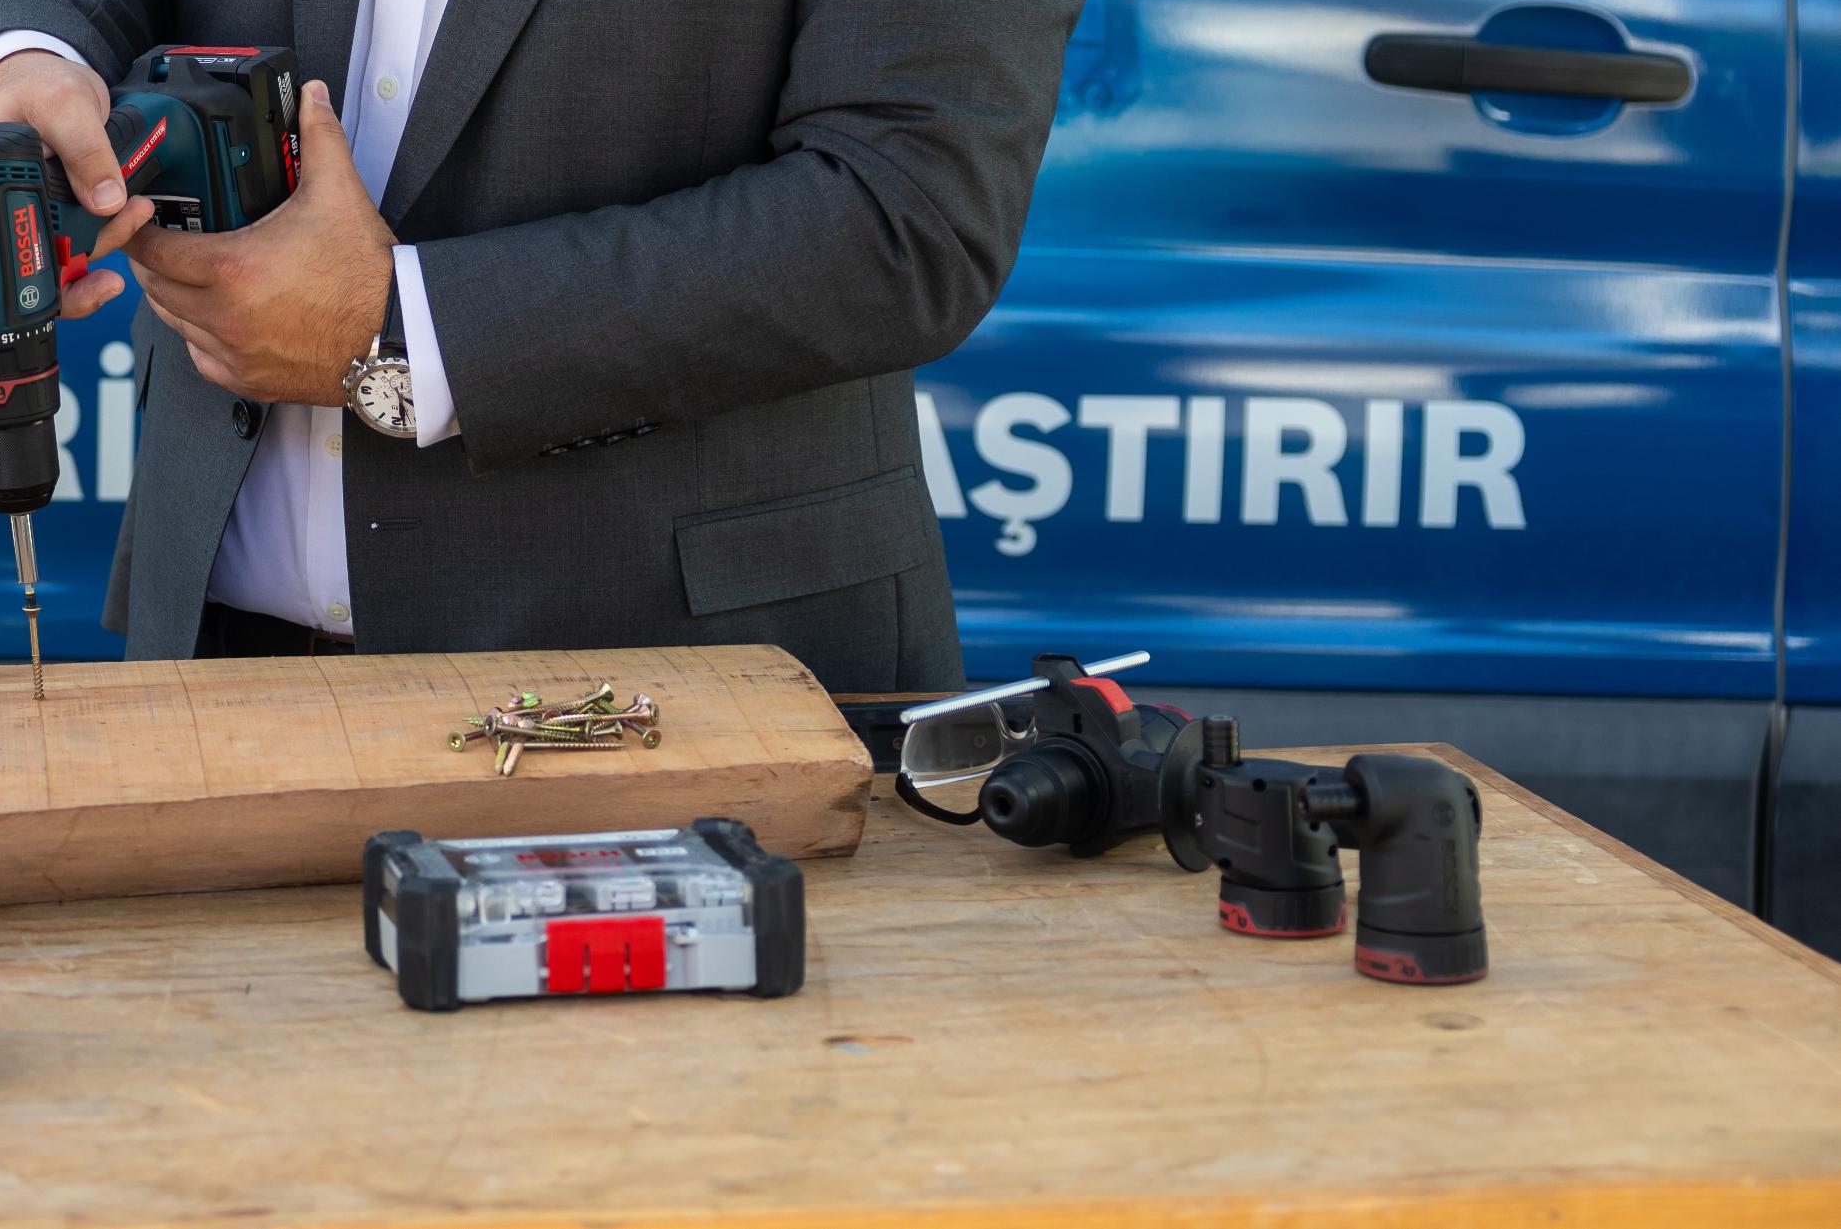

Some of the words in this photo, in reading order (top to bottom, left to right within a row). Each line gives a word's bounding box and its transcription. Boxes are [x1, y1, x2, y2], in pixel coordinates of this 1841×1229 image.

[289, 134, 299, 156] 18V
[14, 207, 35, 277] BOSCH
[1, 332, 15, 344] 15
